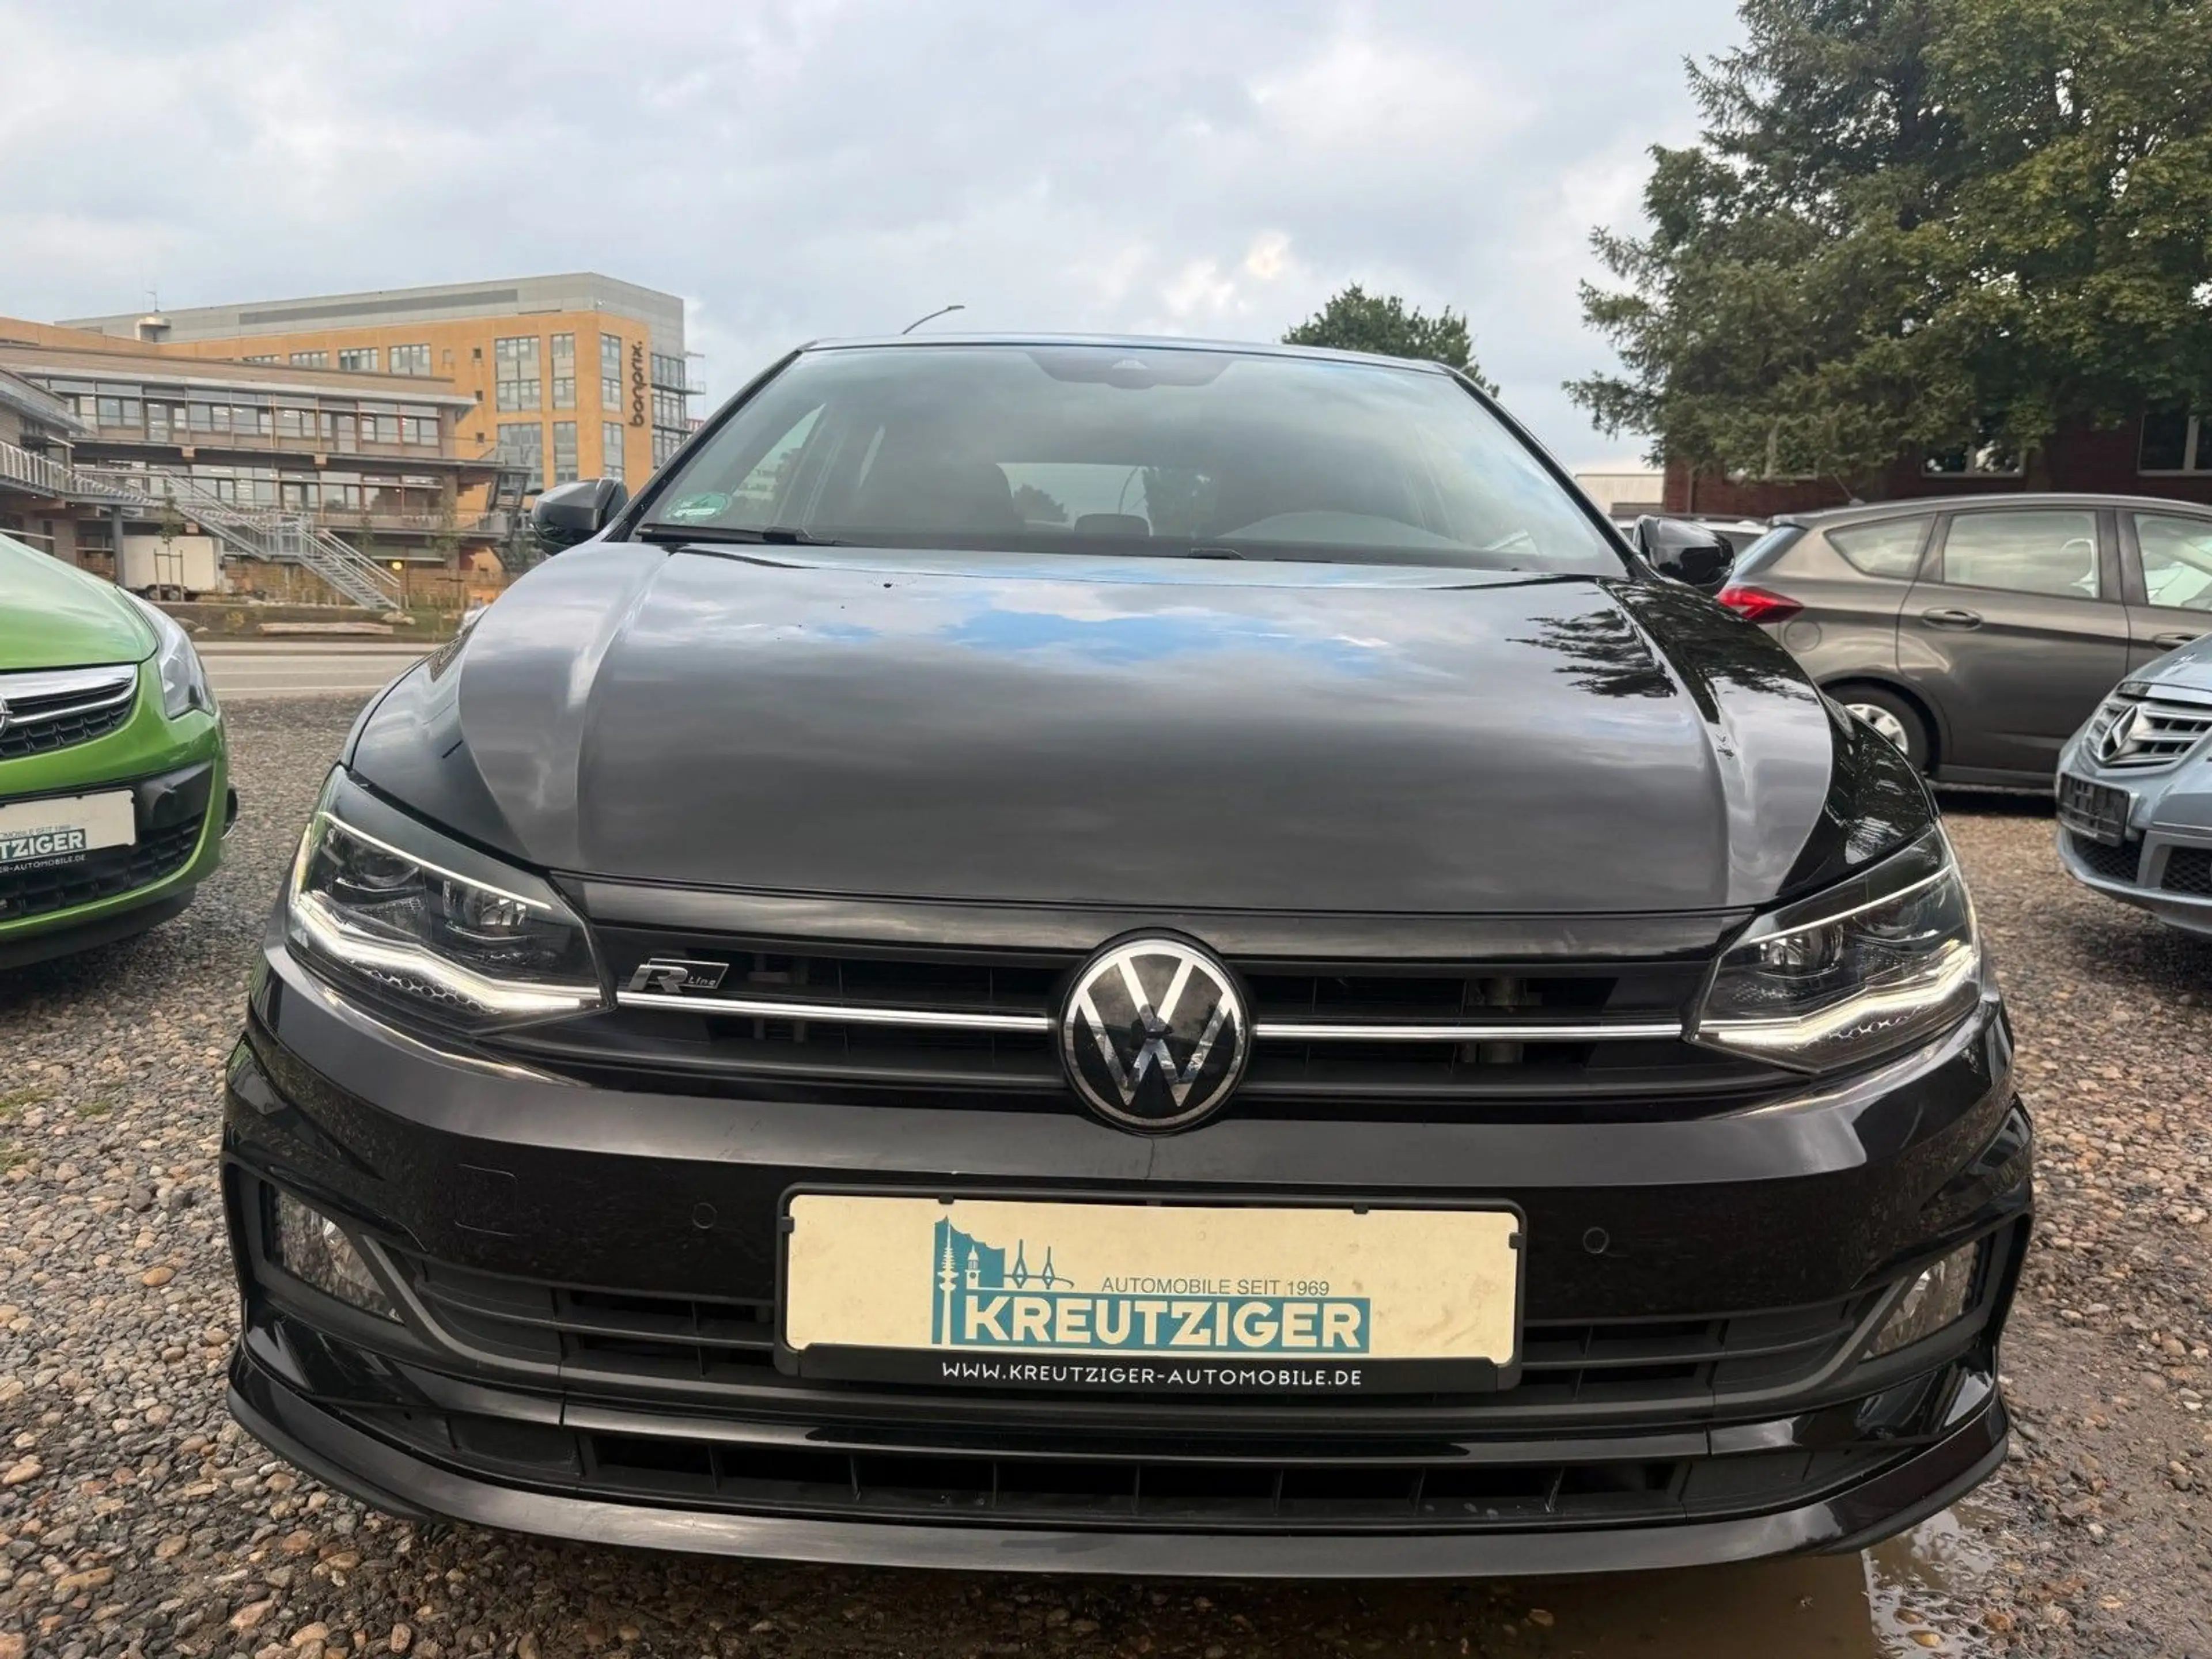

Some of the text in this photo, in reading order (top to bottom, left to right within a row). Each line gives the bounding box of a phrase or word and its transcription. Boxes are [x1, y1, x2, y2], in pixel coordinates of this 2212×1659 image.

[0, 831, 84, 859] TZIGER
[628, 964, 684, 994] R
[1076, 953, 1234, 1107] VW
[1101, 1277, 1330, 1297] AUTOMOBILE SEIT 1969
[964, 1295, 1361, 1348] KREUTZIGER
[942, 1362, 1362, 1385] WWW.KREUTZIGER-AUTOMOBILE.DE
